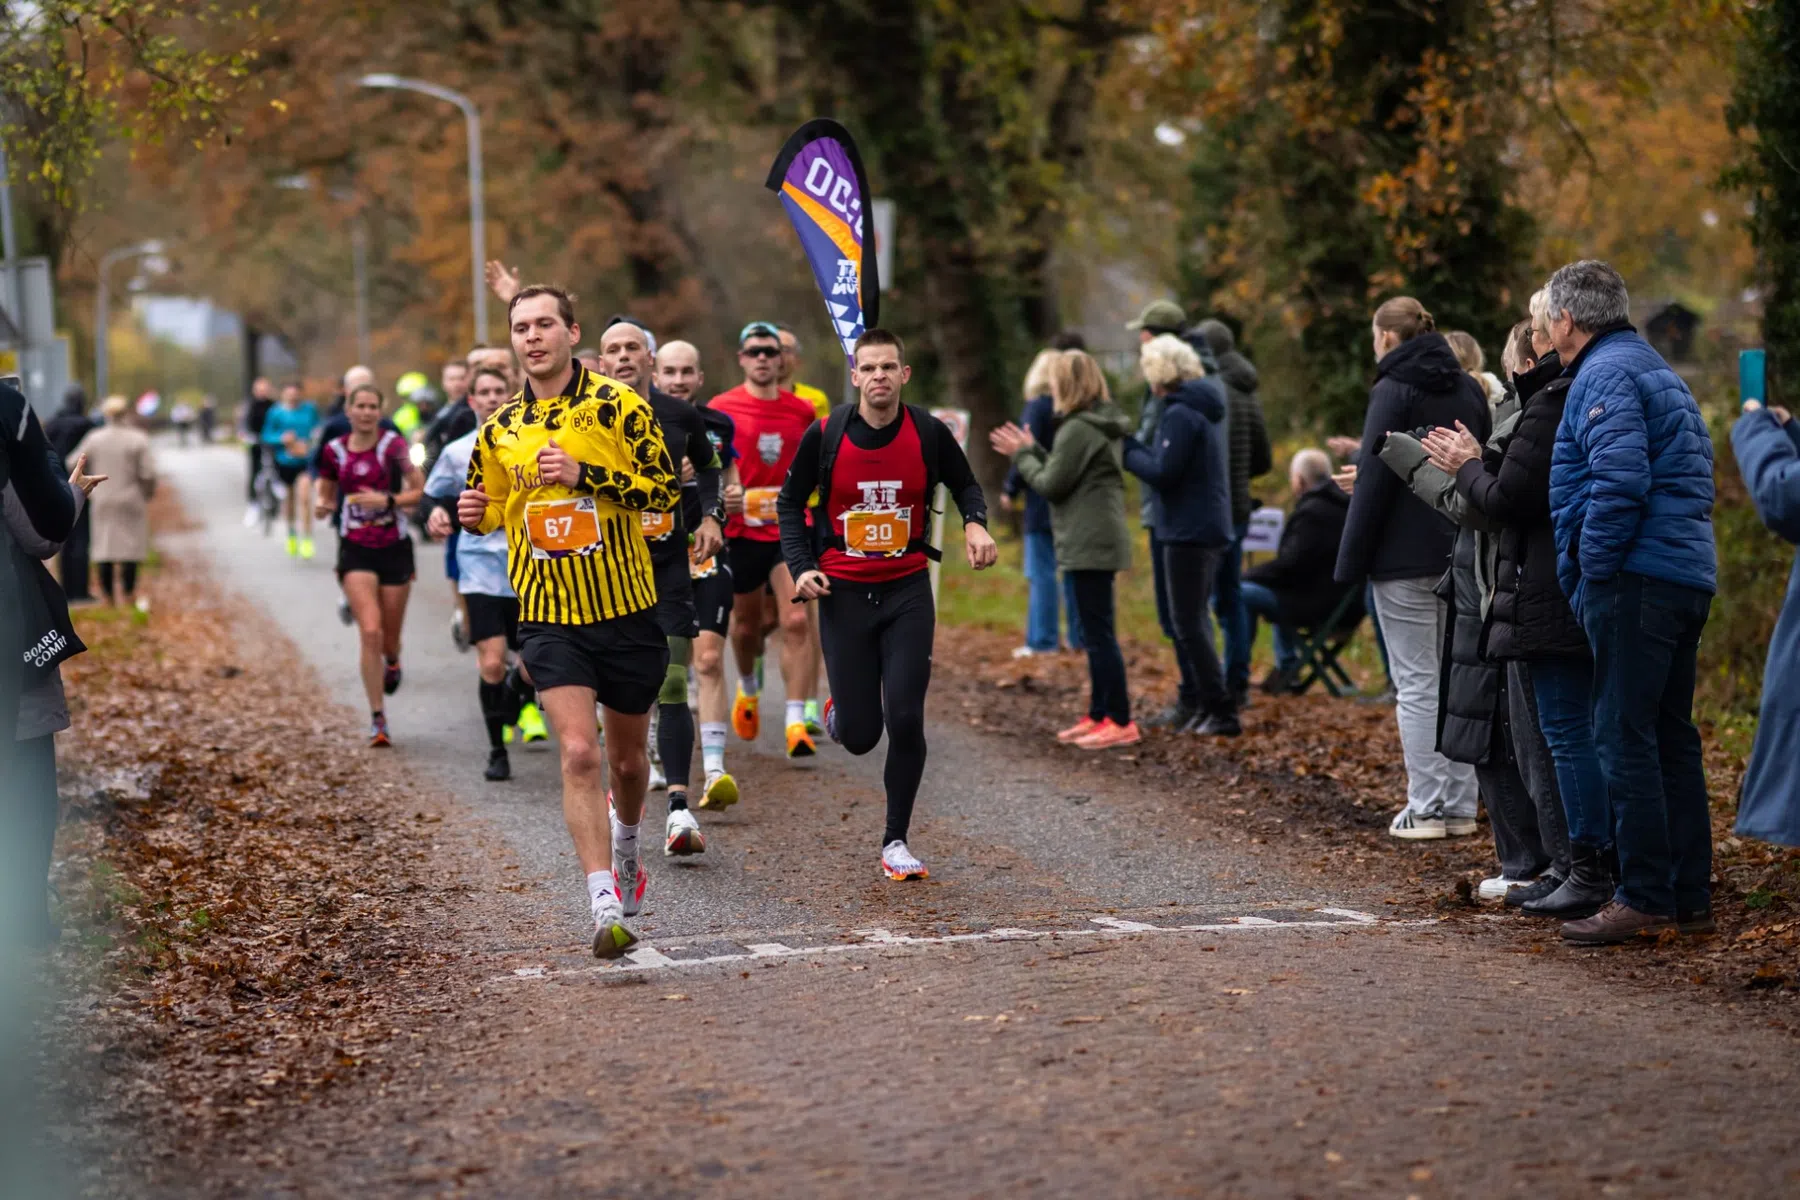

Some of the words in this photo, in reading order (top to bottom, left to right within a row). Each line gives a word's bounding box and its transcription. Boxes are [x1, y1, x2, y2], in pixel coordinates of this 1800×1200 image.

[573, 411, 594, 428] BVB
[545, 516, 573, 538] 67
[865, 524, 893, 541] 30
[23, 629, 58, 663] BOARD
